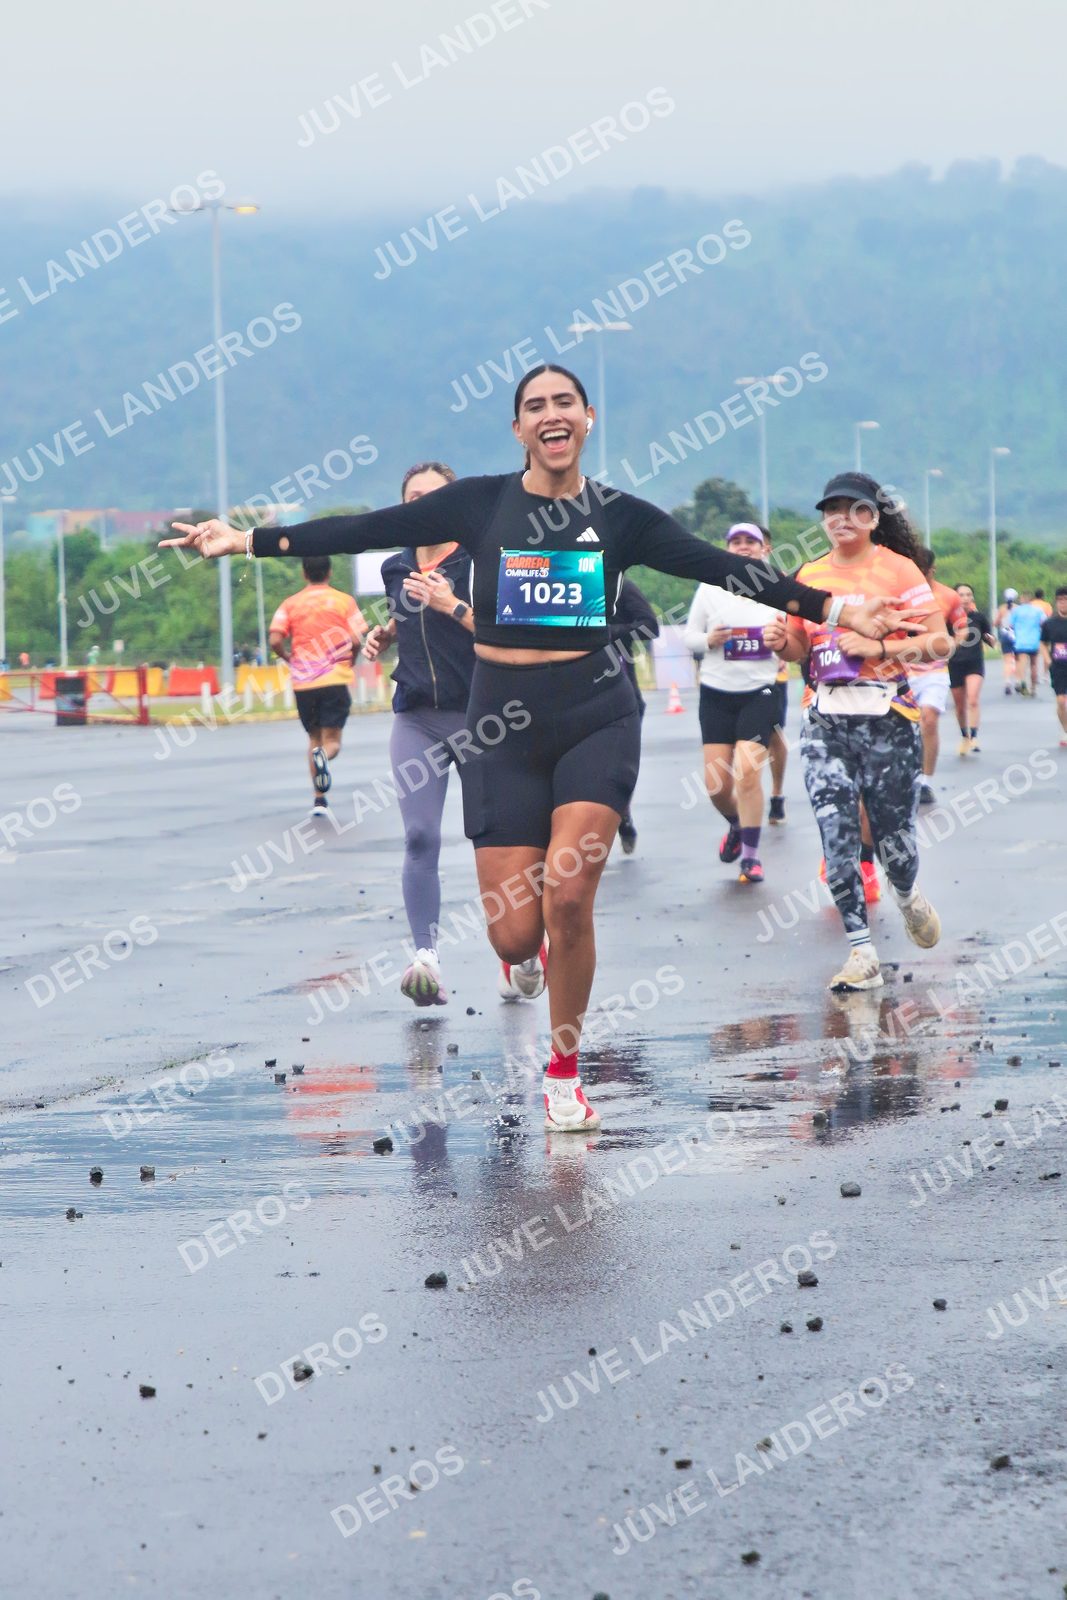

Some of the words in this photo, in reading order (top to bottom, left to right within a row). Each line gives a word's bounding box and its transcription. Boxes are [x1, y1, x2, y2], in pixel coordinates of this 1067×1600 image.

[505, 556, 550, 569] CARRERA
[578, 558, 595, 573] 10K
[520, 582, 583, 604] 1023
[736, 639, 760, 652] 733
